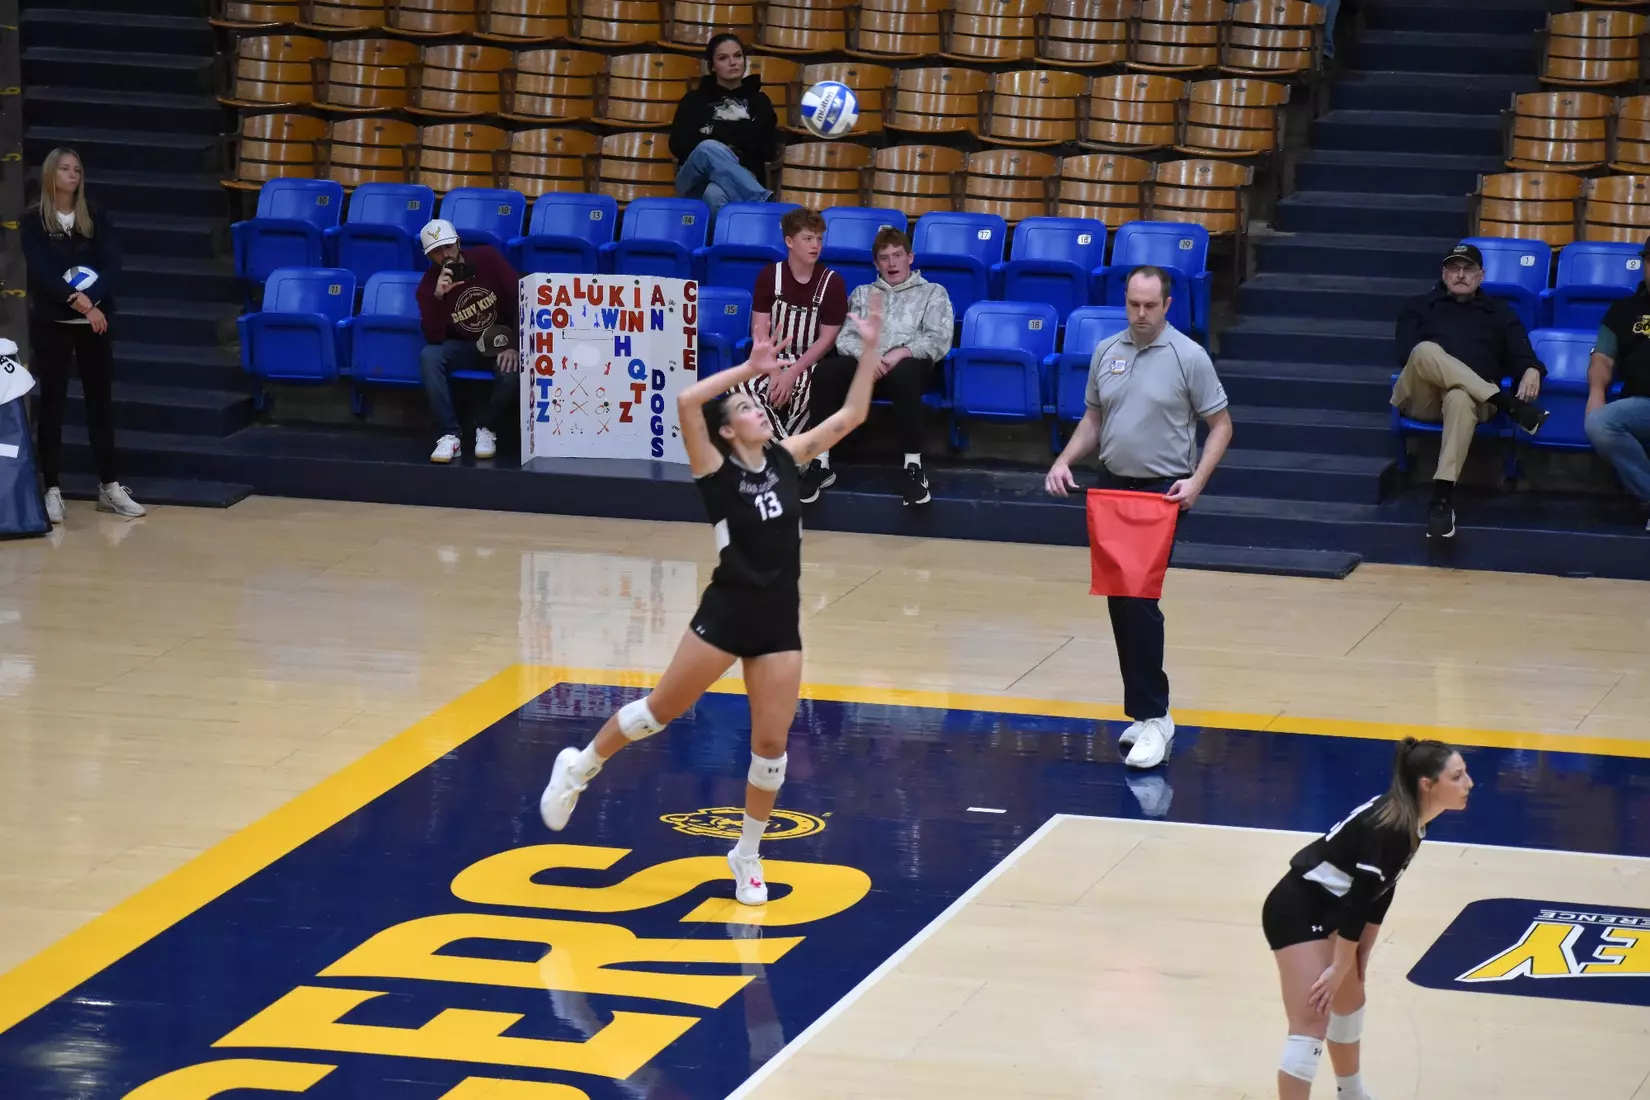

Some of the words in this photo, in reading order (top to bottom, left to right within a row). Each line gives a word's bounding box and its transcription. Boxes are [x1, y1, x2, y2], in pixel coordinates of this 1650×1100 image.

[816, 91, 834, 122] molten
[451, 303, 477, 323] DAIRY
[476, 291, 498, 311] KING
[537, 277, 641, 309] SALUKI
[536, 307, 569, 330] GO
[601, 307, 644, 333] WIN
[683, 281, 697, 371] CUTE
[650, 368, 666, 458] DOGS
[754, 490, 784, 522] 13
